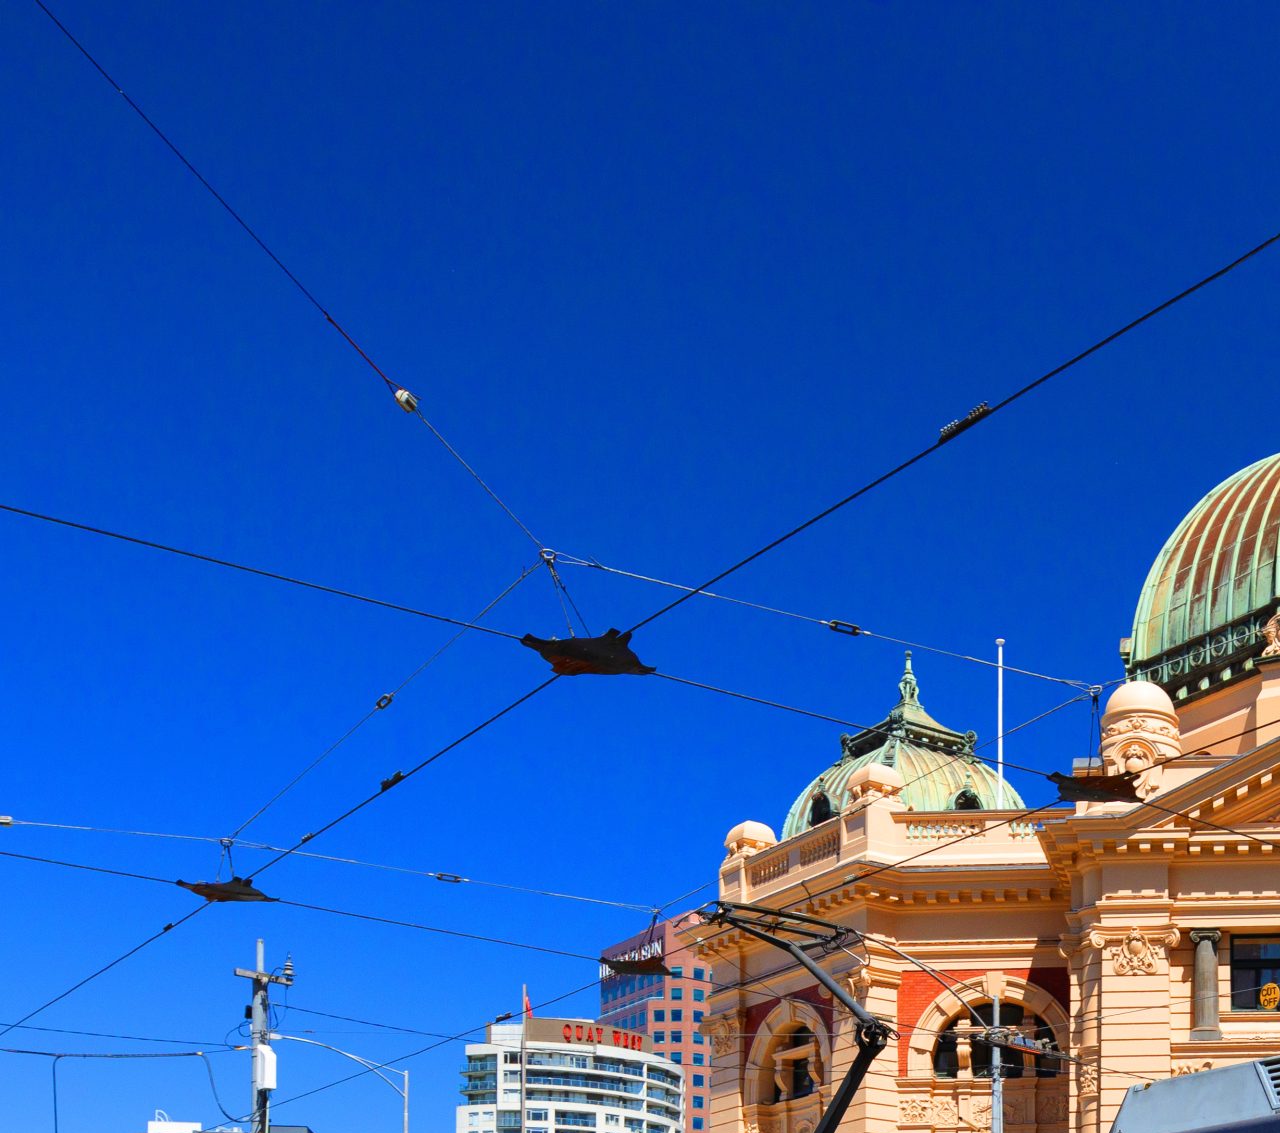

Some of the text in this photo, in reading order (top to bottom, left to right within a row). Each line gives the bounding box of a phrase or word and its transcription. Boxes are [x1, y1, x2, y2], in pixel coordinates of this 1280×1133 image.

[1261, 987, 1277, 997] CUT
[1262, 997, 1278, 1007] OFF
[562, 1024, 643, 1051] QUAY WEST
